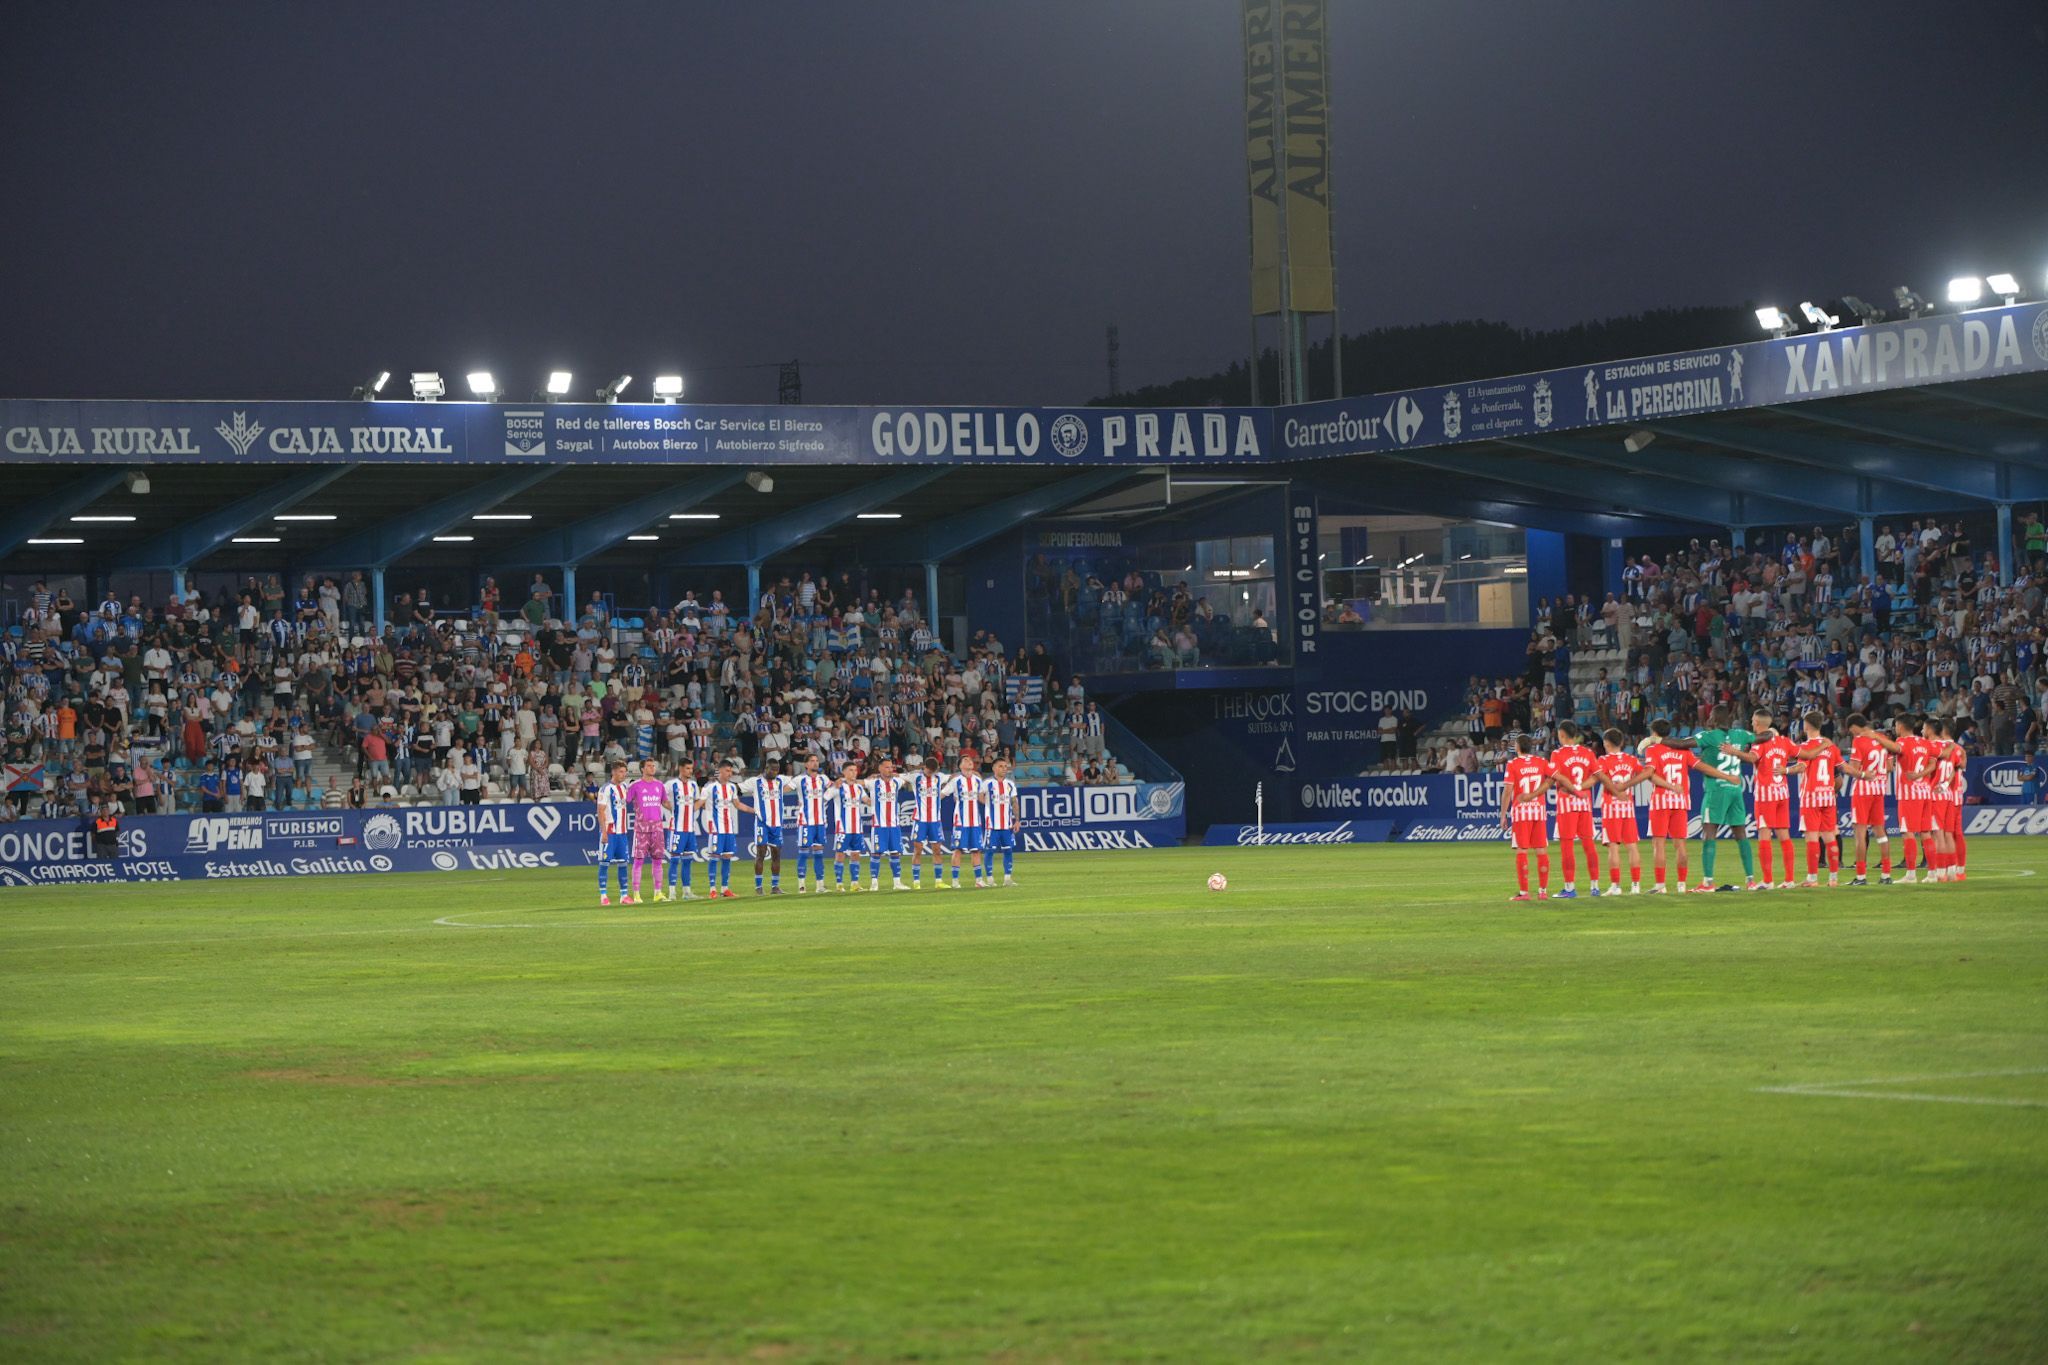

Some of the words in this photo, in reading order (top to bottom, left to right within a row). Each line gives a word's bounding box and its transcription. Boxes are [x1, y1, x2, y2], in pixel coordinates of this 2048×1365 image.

[1247, 0, 1279, 207] ALIMER
[1285, 0, 1327, 208] ALIMER
[1604, 361, 1655, 381] ESTACIÓN
[1657, 361, 1671, 374] DE
[1673, 353, 1721, 371] SERVICIO
[1784, 315, 2023, 395] XAMPRADA
[1467, 387, 1476, 398] El
[1477, 384, 1526, 401] Ayuntamiento
[1606, 389, 1628, 419] LA
[1631, 377, 1723, 417] PEREGRINA
[1471, 403, 1480, 415] de
[1481, 400, 1524, 414] Ponferrada,
[506, 419, 543, 429] BOSCH
[506, 430, 543, 439] Service
[556, 418, 581, 430] Red
[584, 418, 600, 430] de
[603, 417, 650, 430] talleres
[654, 417, 691, 430] Bosch
[694, 418, 717, 431] Car
[719, 419, 766, 431] Service
[769, 419, 781, 431] El
[784, 419, 823, 432] Bierzo
[871, 412, 1041, 457] GODELLO
[1102, 412, 1261, 458] PRADA
[1284, 411, 1381, 449] Carrefour
[1471, 423, 1485, 432] con
[1486, 419, 1494, 430] el
[1495, 418, 1523, 432] deporte
[5, 426, 85, 457] CAJA
[91, 427, 201, 455] RURAL
[269, 426, 345, 457] CAJA
[350, 426, 453, 455] RURAL
[556, 439, 594, 452] Saygal
[612, 439, 660, 450] Autobox
[662, 438, 698, 450] Bierzo
[715, 439, 776, 451] Autobierzo
[778, 439, 825, 452] Sigfredo
[1294, 506, 1314, 582] MUSIC
[1298, 593, 1316, 653] TOUR
[1280, 721, 1294, 732] SPA
[1307, 731, 1330, 741] PARA
[1331, 731, 1343, 741] TU
[1571, 766, 1584, 791] 3
[1662, 763, 1683, 786] 15
[1816, 758, 1831, 785] 4
[1316, 783, 1362, 809] tvitec
[1367, 781, 1428, 807] rocalux
[229, 816, 263, 826] HERMANOS
[269, 820, 341, 835] TURISMO
[406, 809, 515, 836] RUBIAL
[1237, 820, 1355, 846] Gancedo
[1405, 824, 1453, 841] Estrella
[1452, 823, 1504, 841] Galicia
[1023, 829, 1154, 852] ALIMERKA
[30, 863, 116, 880] CAMAROTE
[123, 861, 178, 876] HOTEL
[204, 860, 289, 878] Estrella
[290, 855, 368, 875] Galicia
[466, 849, 560, 870] tvitec
